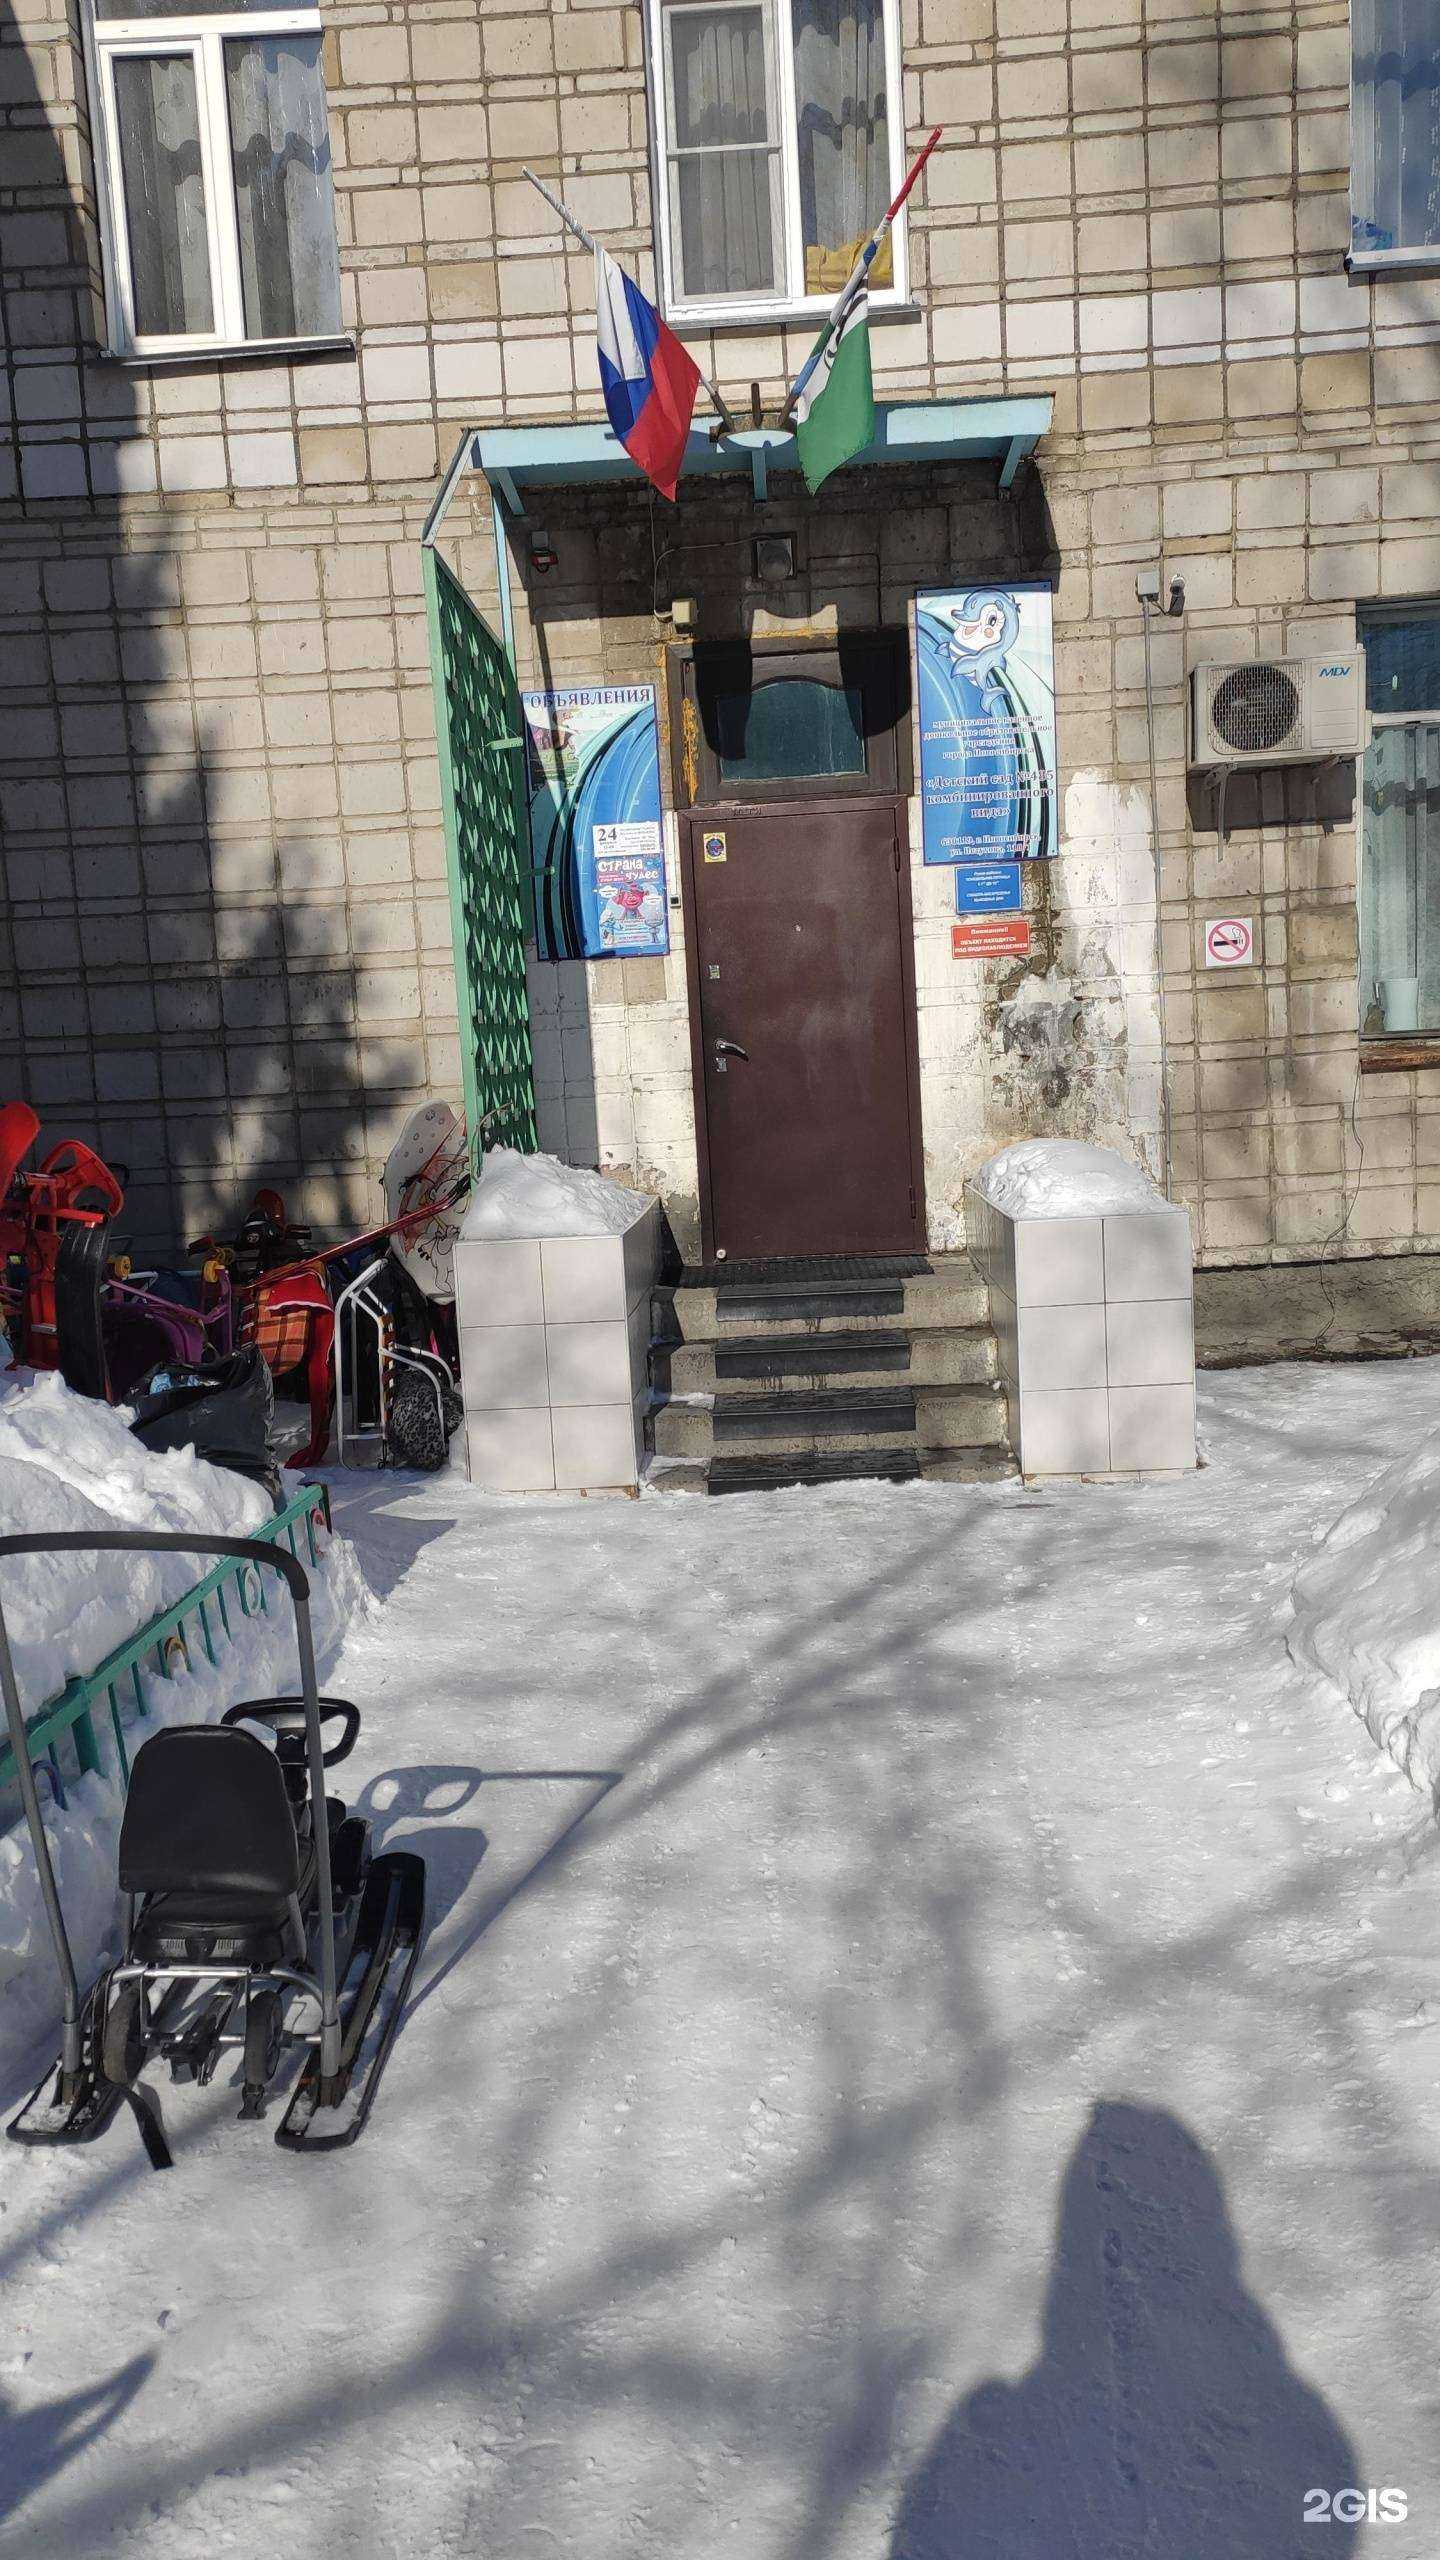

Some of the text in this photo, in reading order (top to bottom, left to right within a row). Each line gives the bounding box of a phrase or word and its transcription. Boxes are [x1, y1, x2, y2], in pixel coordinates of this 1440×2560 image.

[1319, 666, 1350, 677] MDV
[530, 689, 650, 708] ОБЪЯВЛЕНИЯ
[991, 773, 1013, 786] сад
[927, 788, 1054, 804] комбинированного
[598, 827, 617, 841] 24
